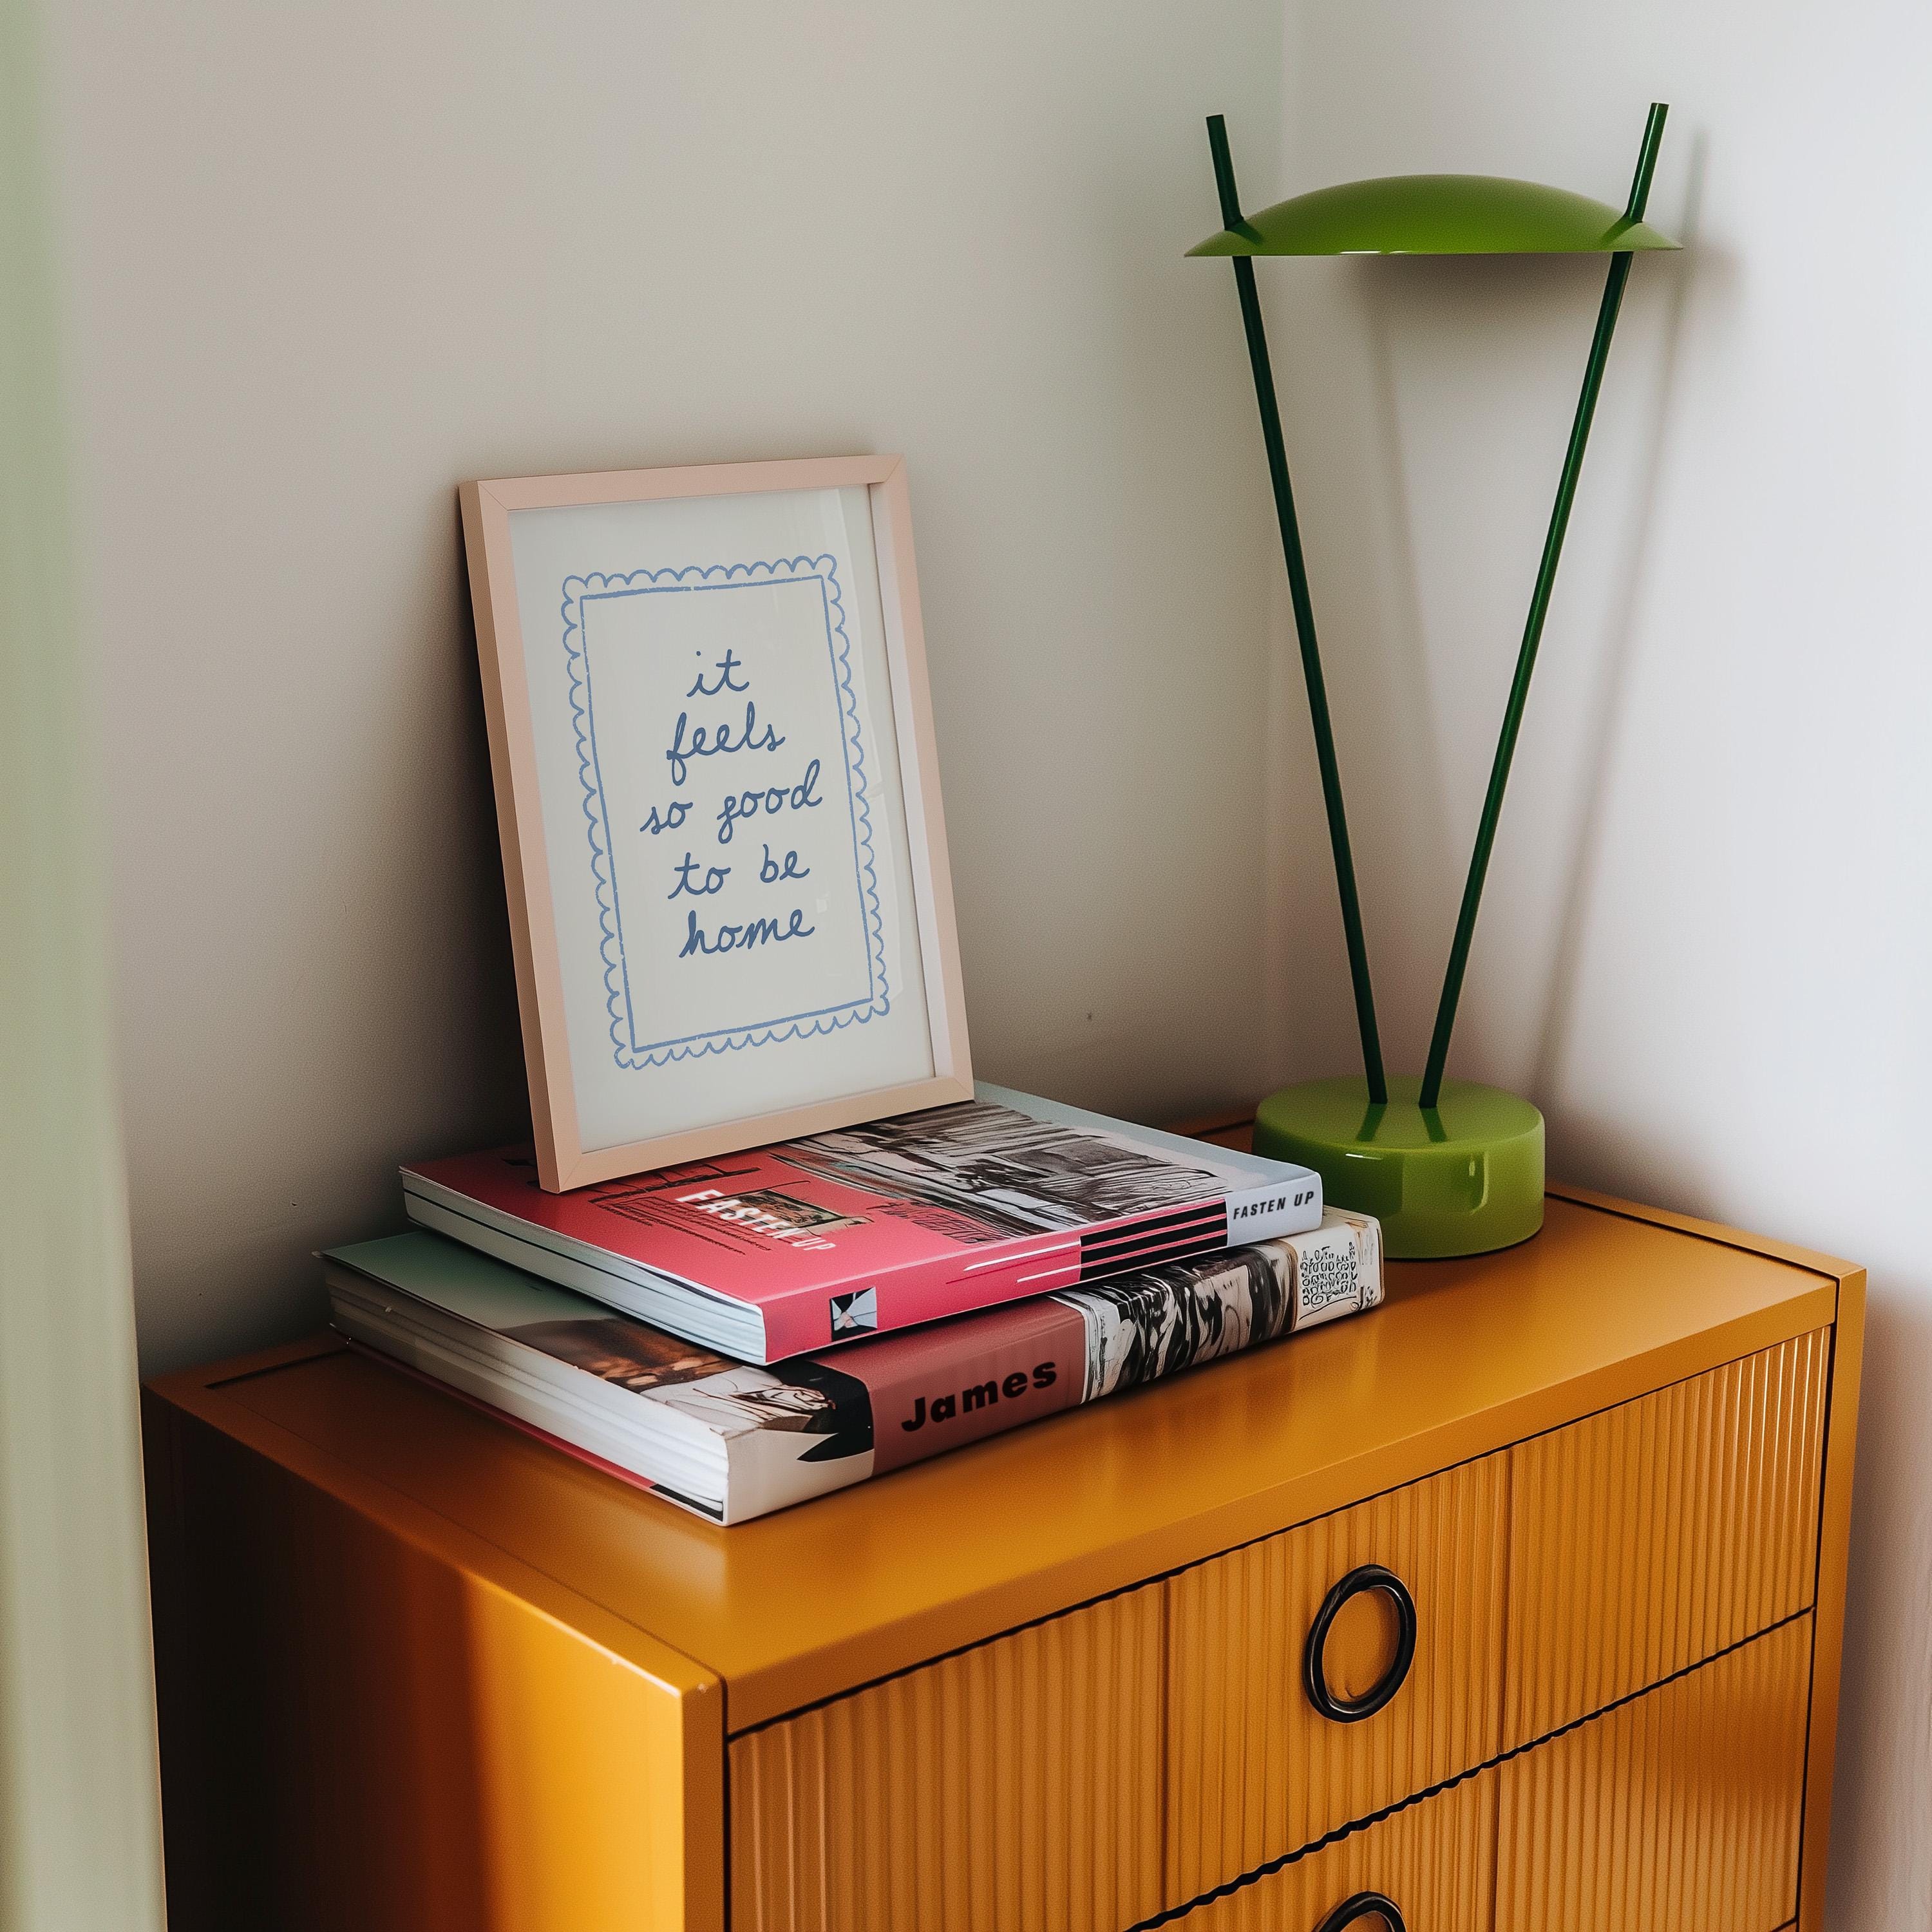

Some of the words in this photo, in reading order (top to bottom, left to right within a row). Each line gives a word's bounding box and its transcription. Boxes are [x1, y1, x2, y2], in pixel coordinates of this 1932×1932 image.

[687, 649, 750, 697] it
[667, 701, 786, 786] feels
[640, 802, 694, 835] so
[717, 759, 823, 844] good
[668, 852, 732, 900] to
[760, 844, 811, 883] be
[678, 909, 815, 958] home
[674, 1188, 807, 1240] FASTEN
[792, 1236, 837, 1252] UP
[1233, 1197, 1287, 1220] FASTEN
[1294, 1191, 1314, 1207] UP
[901, 1361, 1058, 1433] James
